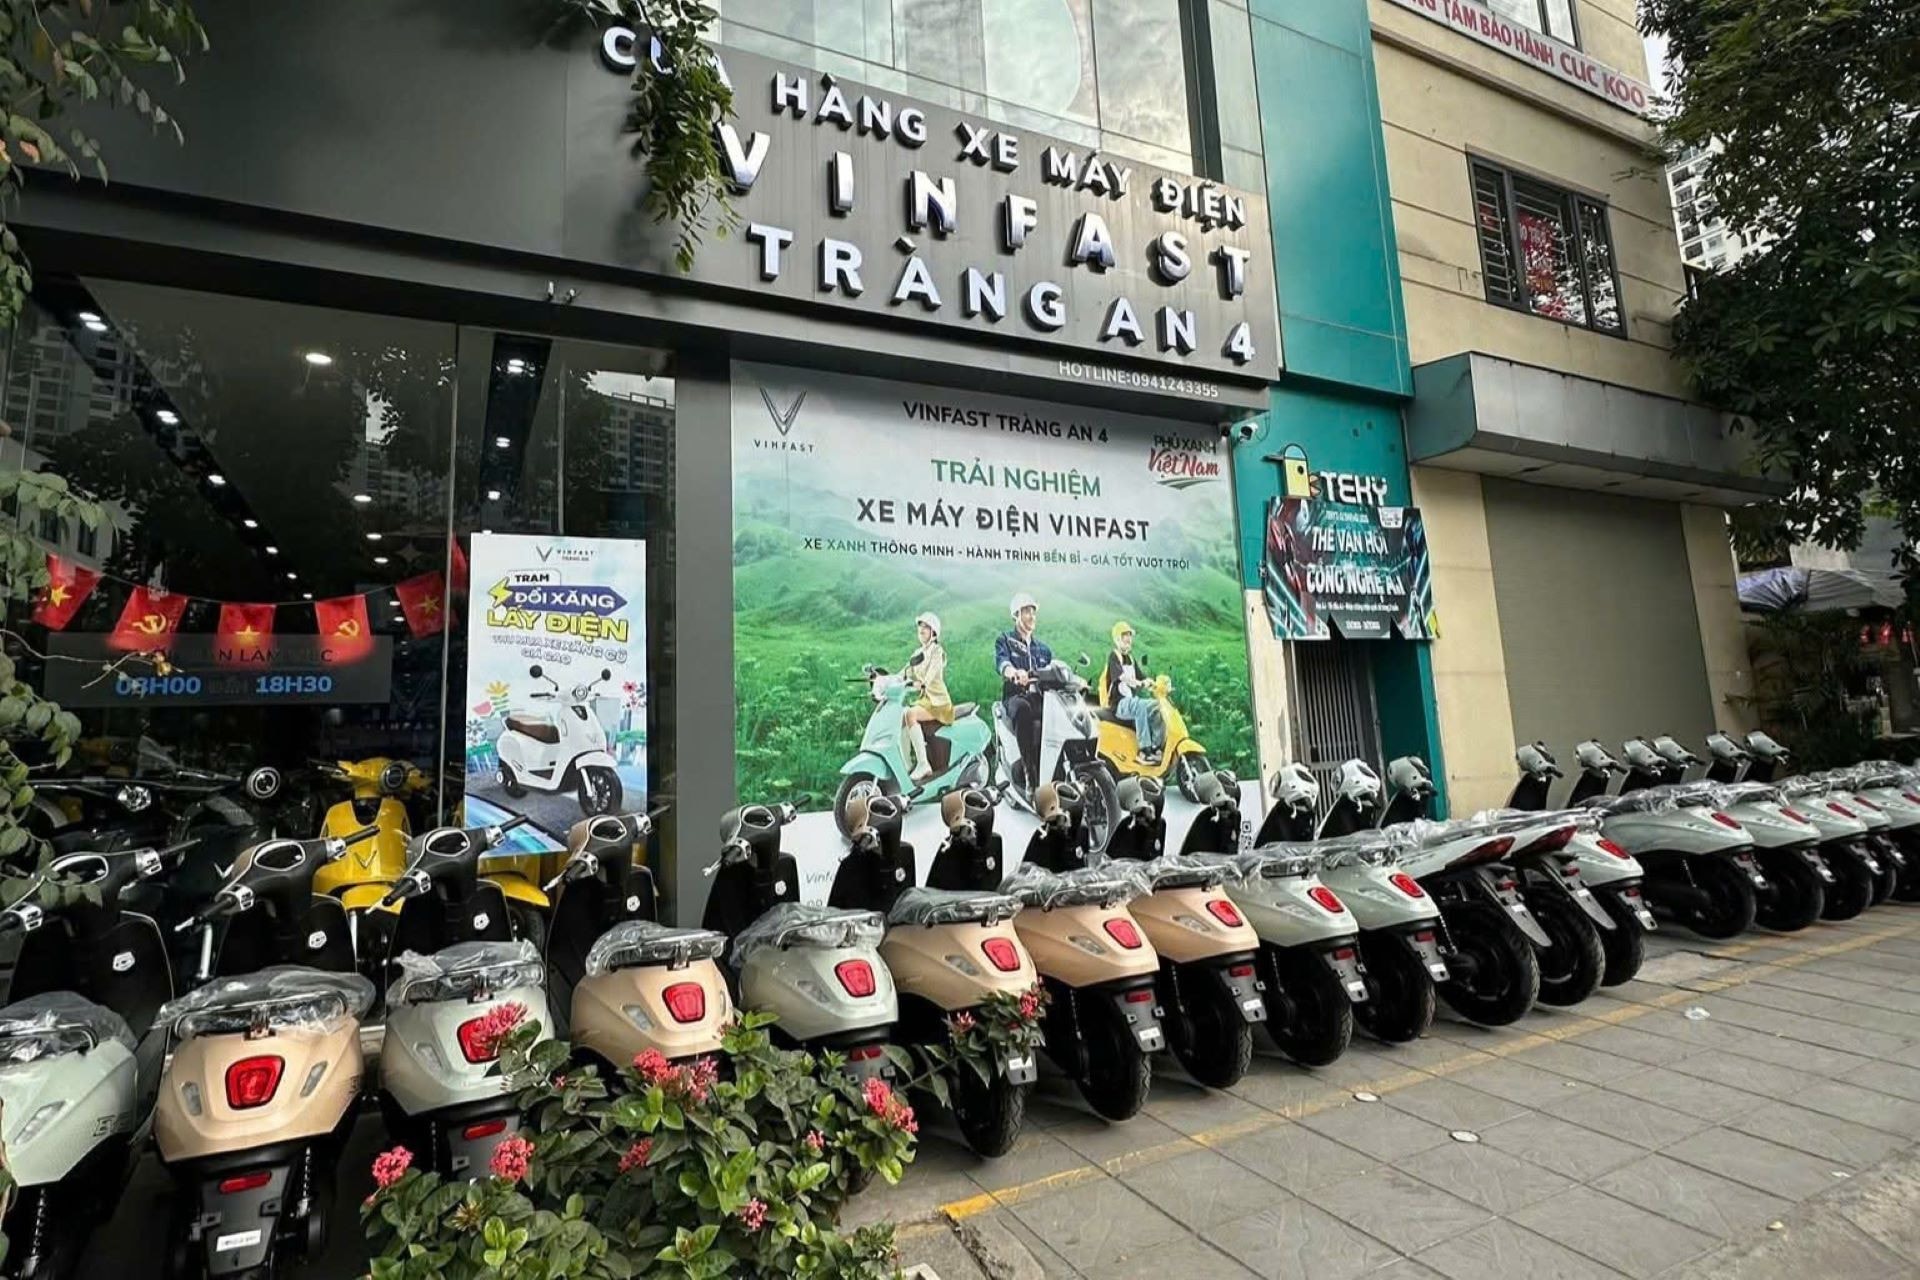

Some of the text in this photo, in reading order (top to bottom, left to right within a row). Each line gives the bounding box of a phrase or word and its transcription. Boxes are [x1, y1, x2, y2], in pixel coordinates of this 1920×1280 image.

[1480, 11, 1512, 46] BẢO
[1514, 28, 1555, 67] HÀNH
[773, 71, 1245, 232] HÀNG XE MÁY ĐIỆN
[714, 122, 1250, 297] VINFAST
[748, 222, 1255, 365] TRÀNG AN 4
[903, 401, 1109, 443] VINFAST TRÀNG AN 4
[754, 439, 815, 453] VINFAST
[1180, 452, 1218, 477] Nam
[1182, 438, 1217, 455] XANH
[931, 457, 1101, 500] TRẢI NGHIỆM
[1319, 471, 1387, 506] TEKY
[857, 498, 1149, 541] XE MÁY ĐIỆN VINFAST
[804, 538, 822, 549] XE
[827, 539, 866, 551] XANH
[870, 539, 917, 555] THÔNG
[922, 544, 953, 557] MINH
[966, 545, 1001, 559] HÀNH
[1005, 546, 1040, 561] TRÌNH
[552, 590, 615, 609] XĂNG
[487, 605, 628, 642] LẤY ĐIỆN
[256, 676, 332, 694] 18H30
